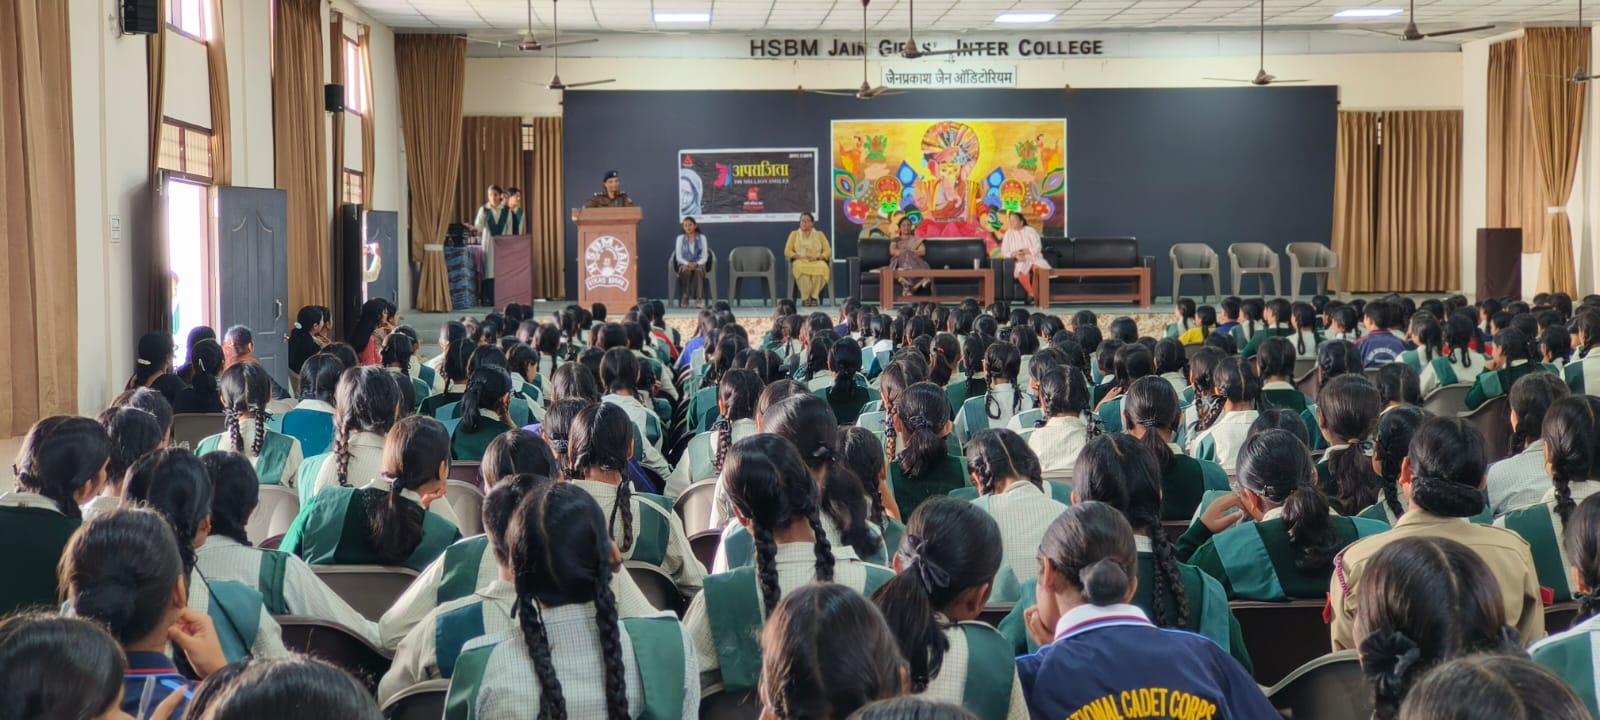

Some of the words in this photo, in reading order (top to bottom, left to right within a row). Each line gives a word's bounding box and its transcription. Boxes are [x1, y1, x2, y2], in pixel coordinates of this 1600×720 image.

[750, 39, 818, 57] HSBM
[828, 39, 867, 56] JAIN
[879, 39, 937, 57] GIS'
[957, 39, 1009, 56] INTER
[1018, 38, 1103, 56] COLLEGE
[885, 68, 932, 84] जैनप्रकाश
[935, 68, 952, 84] जैन
[953, 68, 1013, 84] ऑडिटोरियम
[732, 160, 789, 177] अपराजिता
[1066, 694, 1124, 720] TIONAL
[1120, 687, 1168, 718] CADET
[1169, 690, 1217, 720] CORPS
